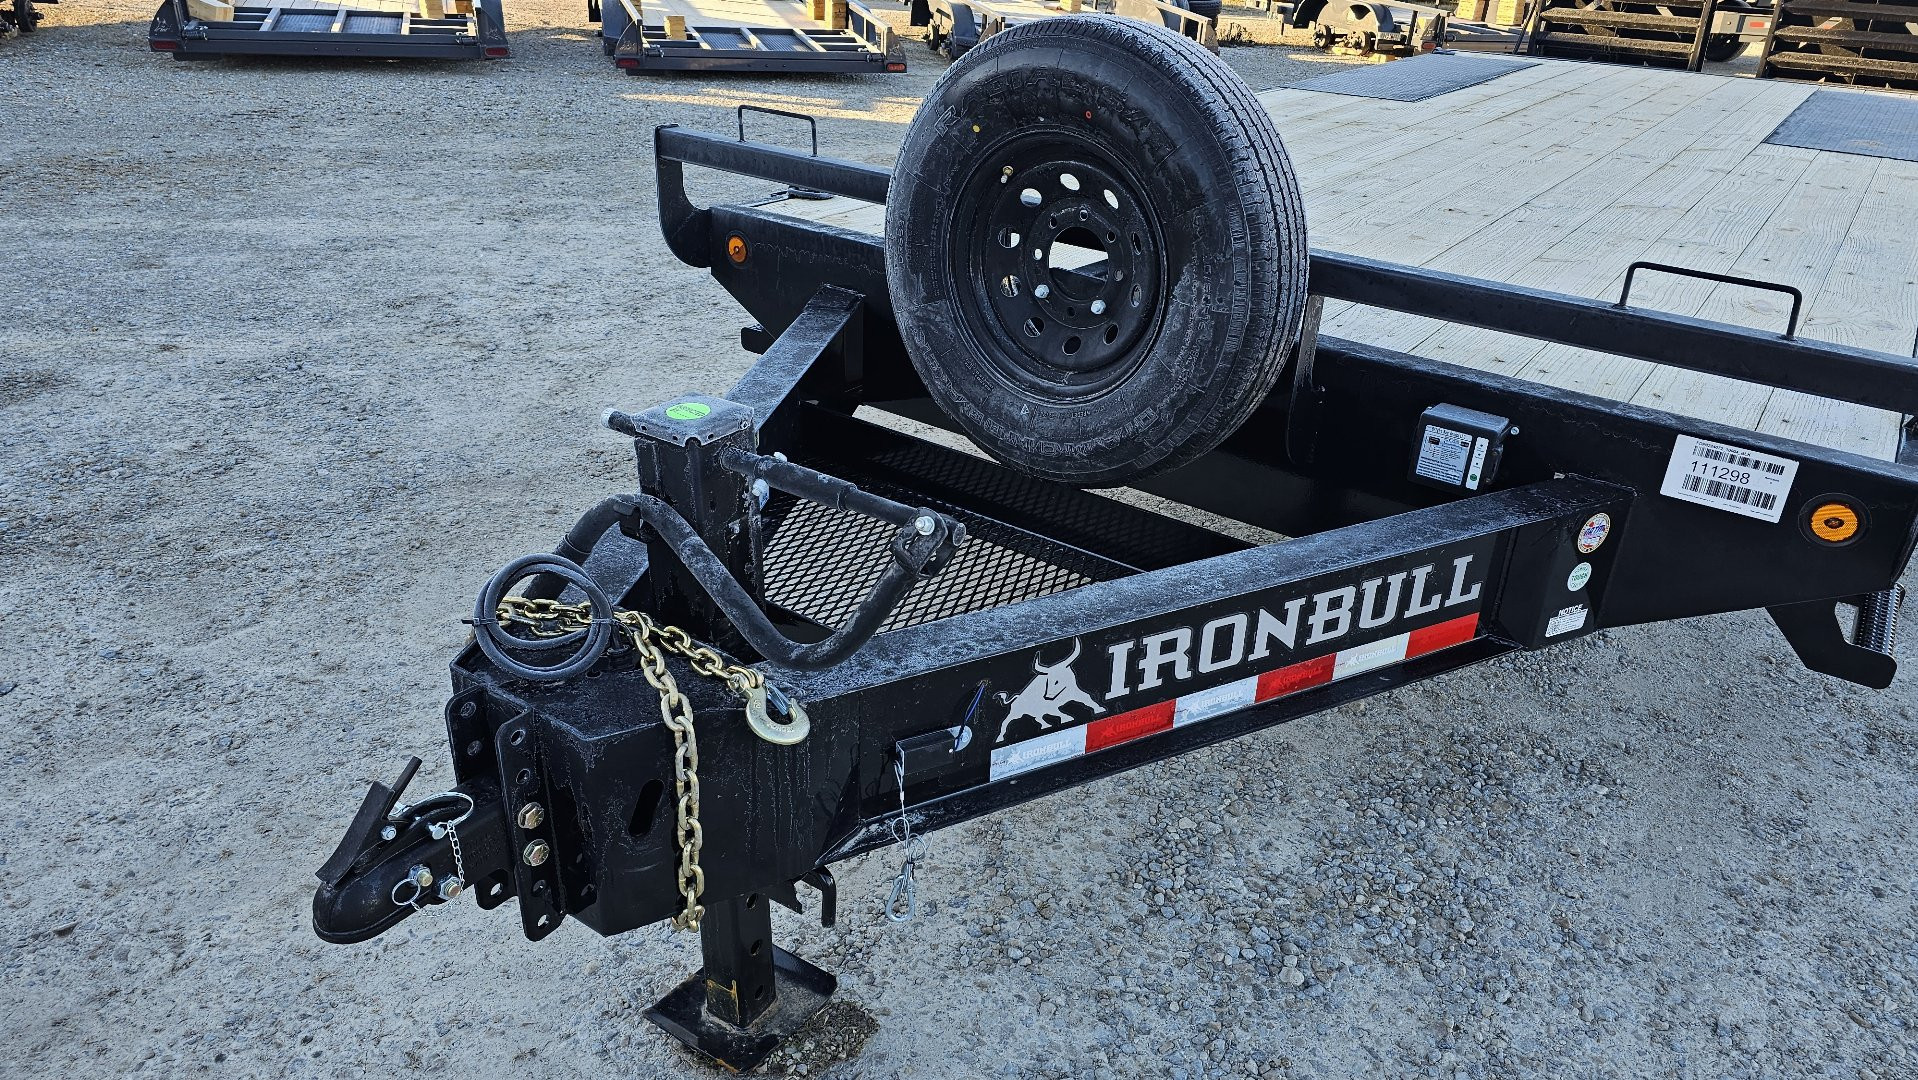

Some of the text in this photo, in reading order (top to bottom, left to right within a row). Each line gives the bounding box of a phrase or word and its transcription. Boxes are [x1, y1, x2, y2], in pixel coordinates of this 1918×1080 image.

[1691, 460, 1751, 485] 111298
[1559, 604, 1583, 617] NOTICE
[1105, 555, 1481, 700] IRONBULL
[1200, 690, 1244, 709] IRONBULL
[1115, 713, 1163, 733] IRONBULL
[1022, 739, 1072, 760] IRONBULL
